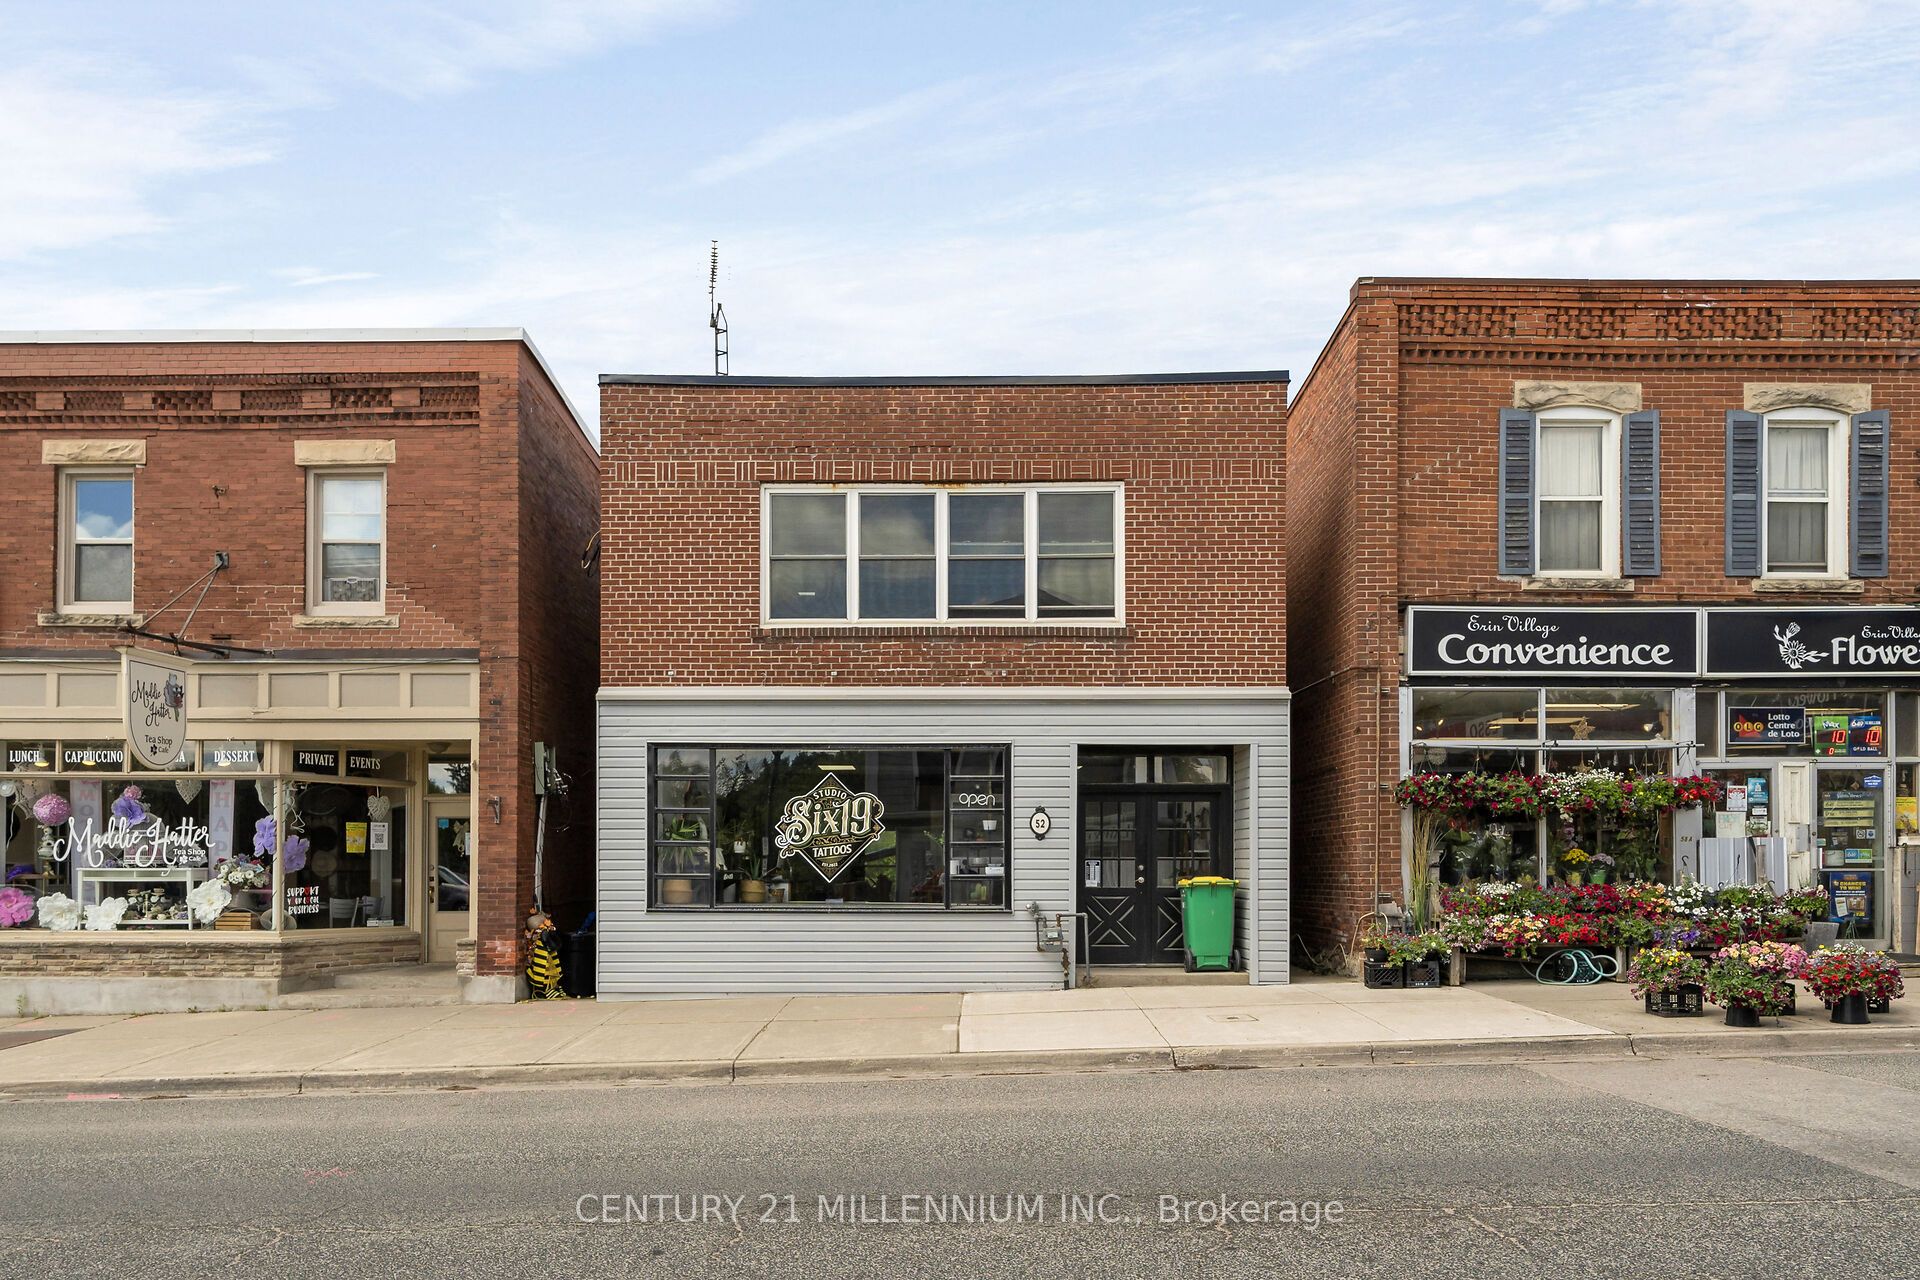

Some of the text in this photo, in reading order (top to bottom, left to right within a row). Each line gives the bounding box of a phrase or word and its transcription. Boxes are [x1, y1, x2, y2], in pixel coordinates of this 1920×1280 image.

[1467, 614, 1560, 639] Erin Village
[1861, 625, 1889, 639] Erin
[1437, 633, 1674, 665] Convenience
[1830, 634, 1920, 665] Flowe
[132, 680, 161, 708] Maddie
[146, 701, 172, 727] Hatter
[1768, 713, 1790, 721] Lotto
[1733, 721, 1764, 732] OLG
[1768, 722, 1796, 730] Centre
[1768, 729, 1800, 738] de Loto
[1831, 730, 1846, 743] 10
[1865, 730, 1880, 743] 10
[144, 734, 173, 748] Tea Shop
[9, 750, 40, 763] LUNCH
[64, 750, 124, 763] CAPPUCCINO
[214, 750, 255, 763] DESSERT
[299, 751, 335, 767] PRIVATE
[350, 756, 381, 770] EVENTS
[813, 789, 847, 800] STUDIO
[958, 793, 996, 807] open
[1035, 819, 1046, 828] 52
[52, 816, 216, 868] Maddie Hatter
[173, 848, 206, 857] Tea Shop
[812, 844, 853, 858] TATTOOS
